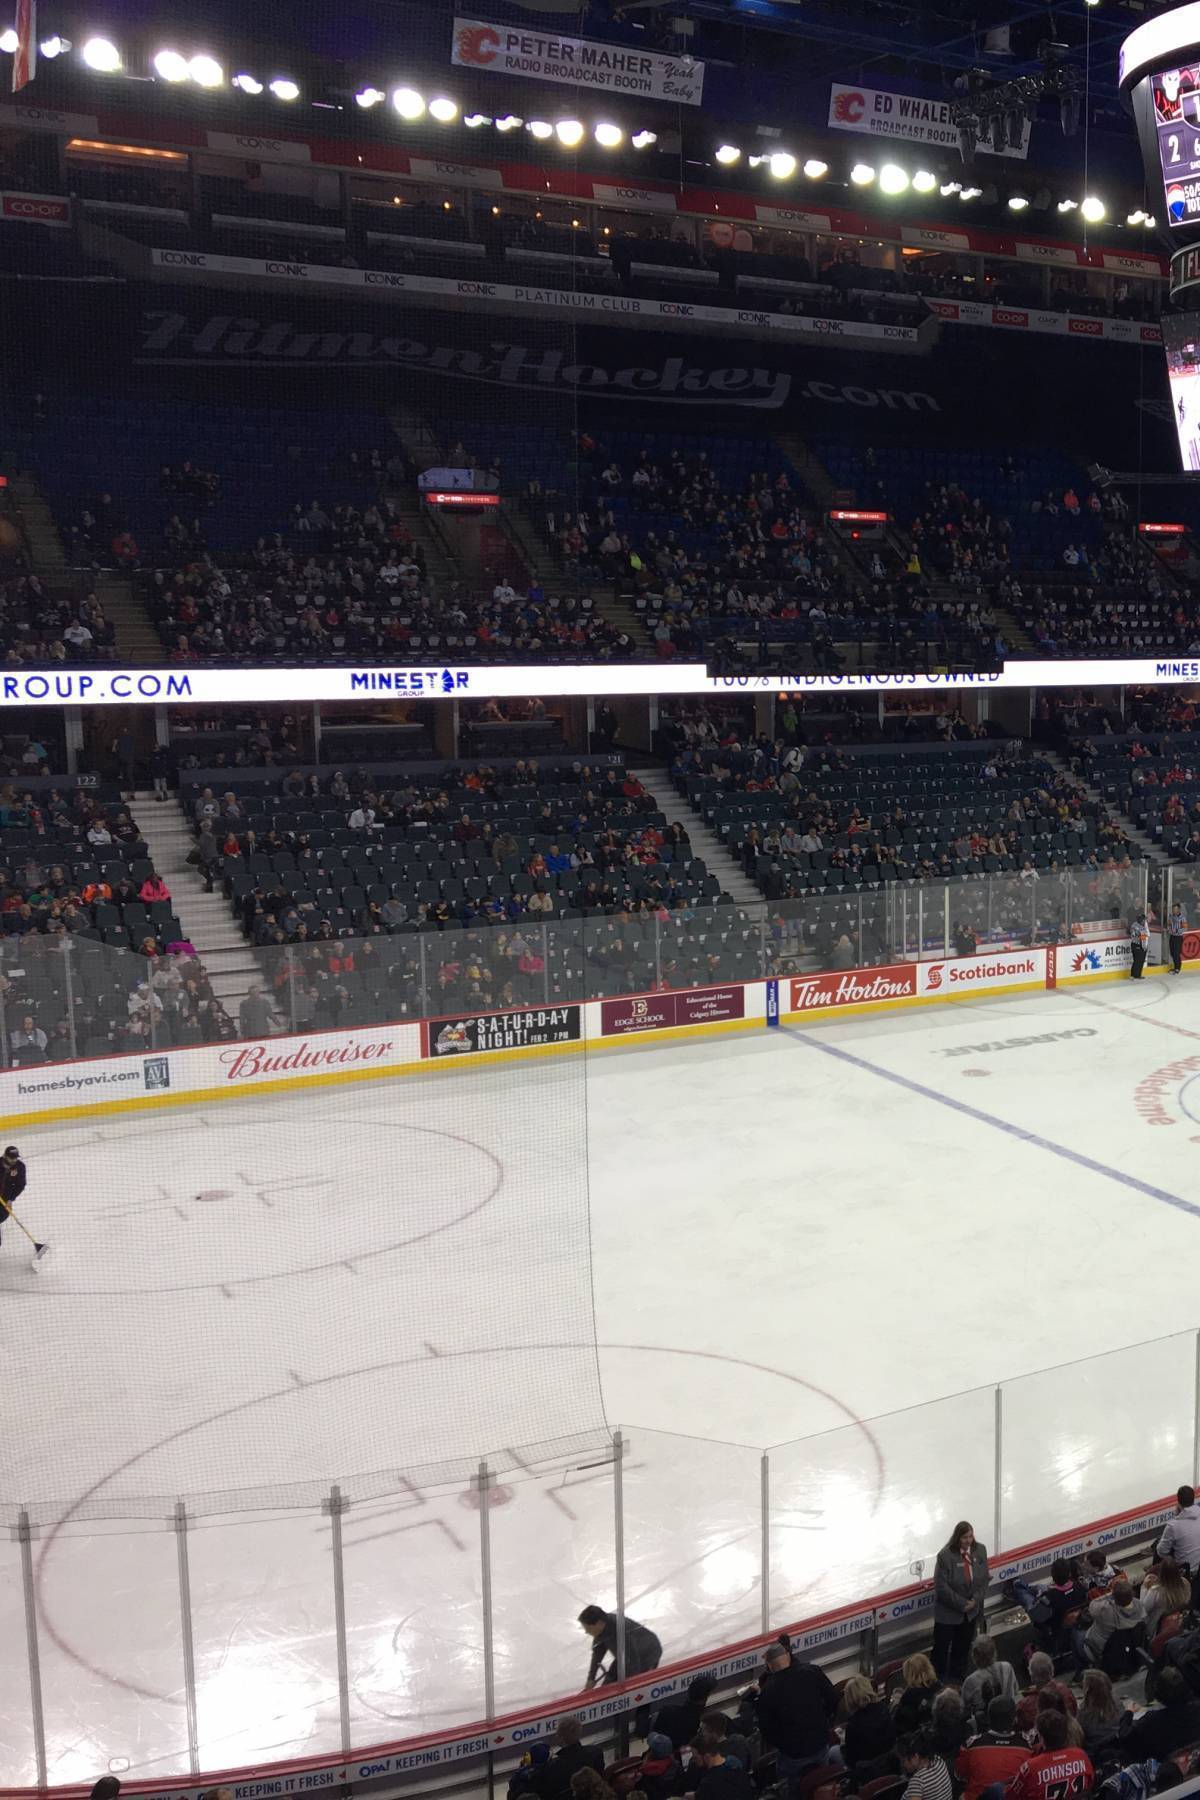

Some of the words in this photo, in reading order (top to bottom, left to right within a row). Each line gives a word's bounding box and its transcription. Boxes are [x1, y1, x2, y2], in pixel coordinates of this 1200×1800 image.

[506, 33, 574, 61] PETER
[581, 47, 652, 76] MAHER
[505, 56, 541, 73] RADIO
[543, 63, 611, 85] BROADCAST
[614, 75, 652, 91] BOOTH
[873, 93, 893, 114] ED
[870, 117, 925, 138] BROADCAST
[926, 128, 958, 144] BOOTH
[1168, 135, 1181, 162] 2
[11, 202, 61, 216] CO-OP
[161, 251, 207, 266] ICONIC
[265, 262, 308, 276] ICONIC
[364, 272, 405, 287] ICONIC
[457, 281, 497, 296] ICONIC
[514, 289, 596, 307] PLATINUM
[601, 298, 641, 312] CLUB
[659, 303, 695, 316] ICONIC
[737, 311, 771, 324] ICONIC
[812, 319, 844, 332] ICONIC
[883, 327, 914, 339] ICONIC
[996, 312, 1025, 324] CO-OP
[1072, 321, 1100, 331] CO-OP
[77, 776, 97, 785] 122
[949, 959, 1035, 981] Scotiabank
[795, 980, 832, 1008] Tim
[835, 976, 912, 1002] Hortons
[477, 1009, 569, 1034] S-A-T-U-R-D-A-Y
[614, 1019, 634, 1027] EDGE
[636, 1013, 666, 1025] SCHOOL
[477, 1030, 528, 1050] NIGHT!
[530, 1035, 542, 1043] FEB
[543, 1034, 548, 1042] 2
[558, 1031, 569, 1040] PM
[219, 1040, 393, 1080] Budweiser
[18, 1071, 140, 1094] homesbyavi.com
[146, 1065, 167, 1082] AVI
[1119, 1519, 1147, 1536] KEEPING
[1022, 1553, 1051, 1571] KEEPING
[1061, 1543, 1083, 1558] FRESH
[803, 1627, 838, 1647] KEEPING
[651, 1680, 677, 1698] OPA!
[730, 1654, 757, 1672] FRESH
[512, 1723, 541, 1742] OPA!
[600, 1697, 630, 1715] FRESH
[359, 1759, 391, 1778] OPA!
[395, 1750, 440, 1770] KEEPING
[456, 1737, 489, 1756] FRESH
[235, 1781, 282, 1798] KEEPING
[299, 1773, 334, 1789] FRESH
[1037, 1760, 1086, 1785] JOHNSON
